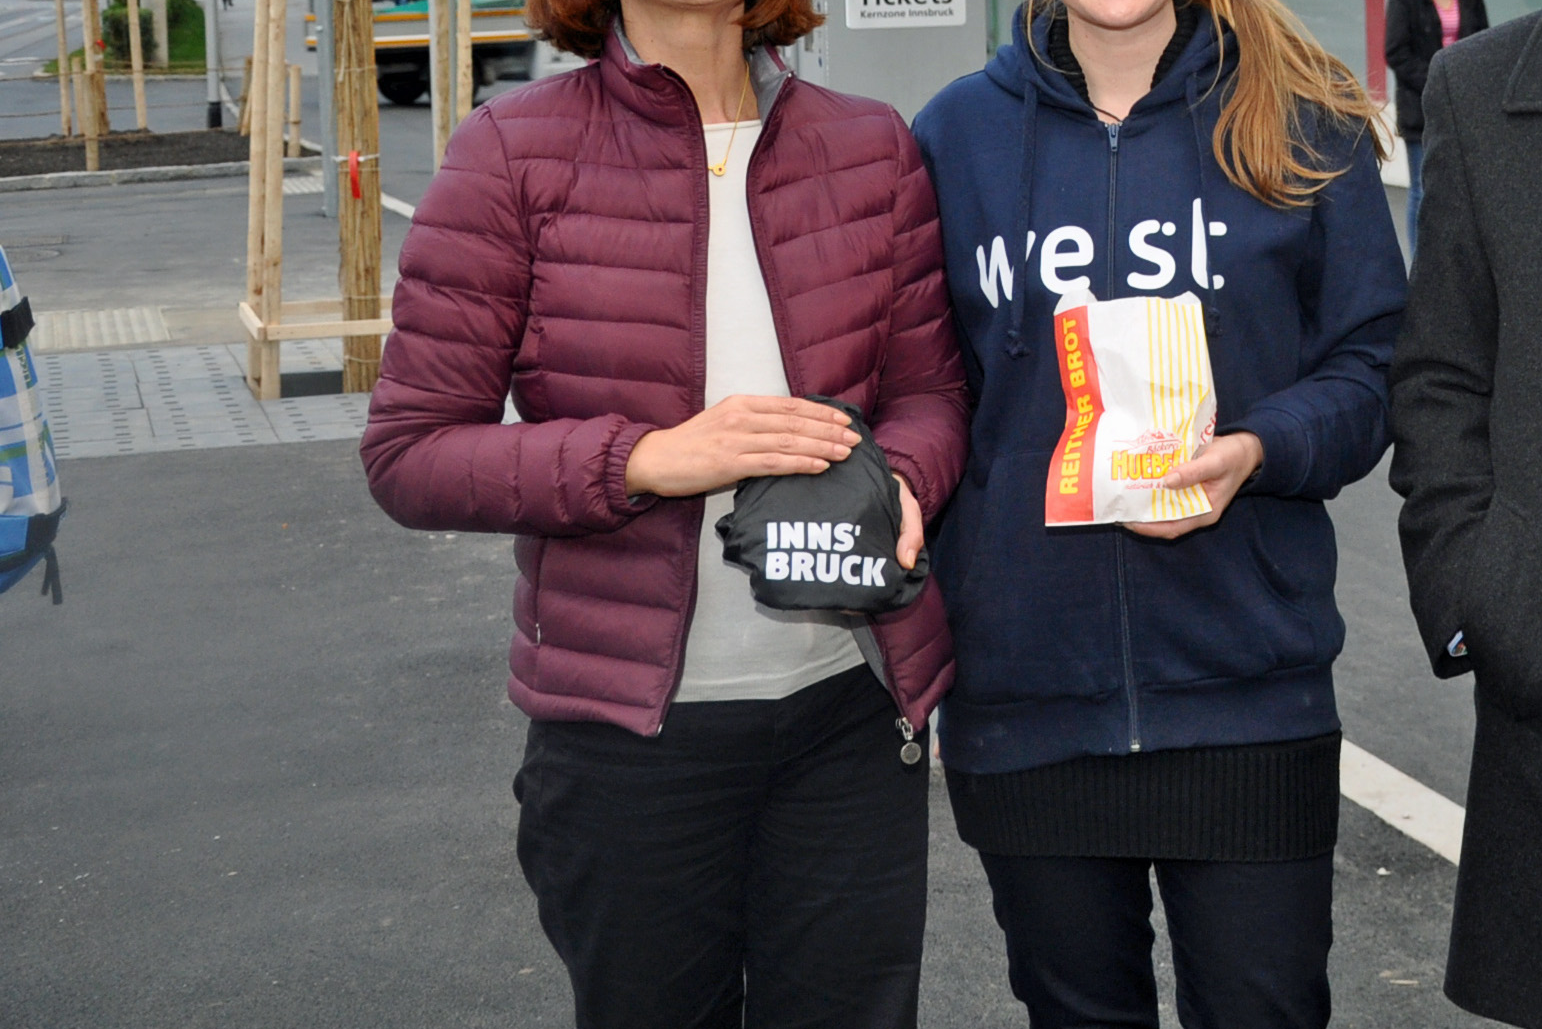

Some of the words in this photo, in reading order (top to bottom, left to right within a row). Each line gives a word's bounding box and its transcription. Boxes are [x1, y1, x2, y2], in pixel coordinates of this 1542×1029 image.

[860, 10, 906, 19] Kernzone
[909, 8, 954, 18] Innsbruck
[1063, 317, 1086, 388] BROT
[1059, 394, 1094, 495] REITHER
[767, 522, 861, 552] INNS'
[766, 552, 887, 587] BRUCK
